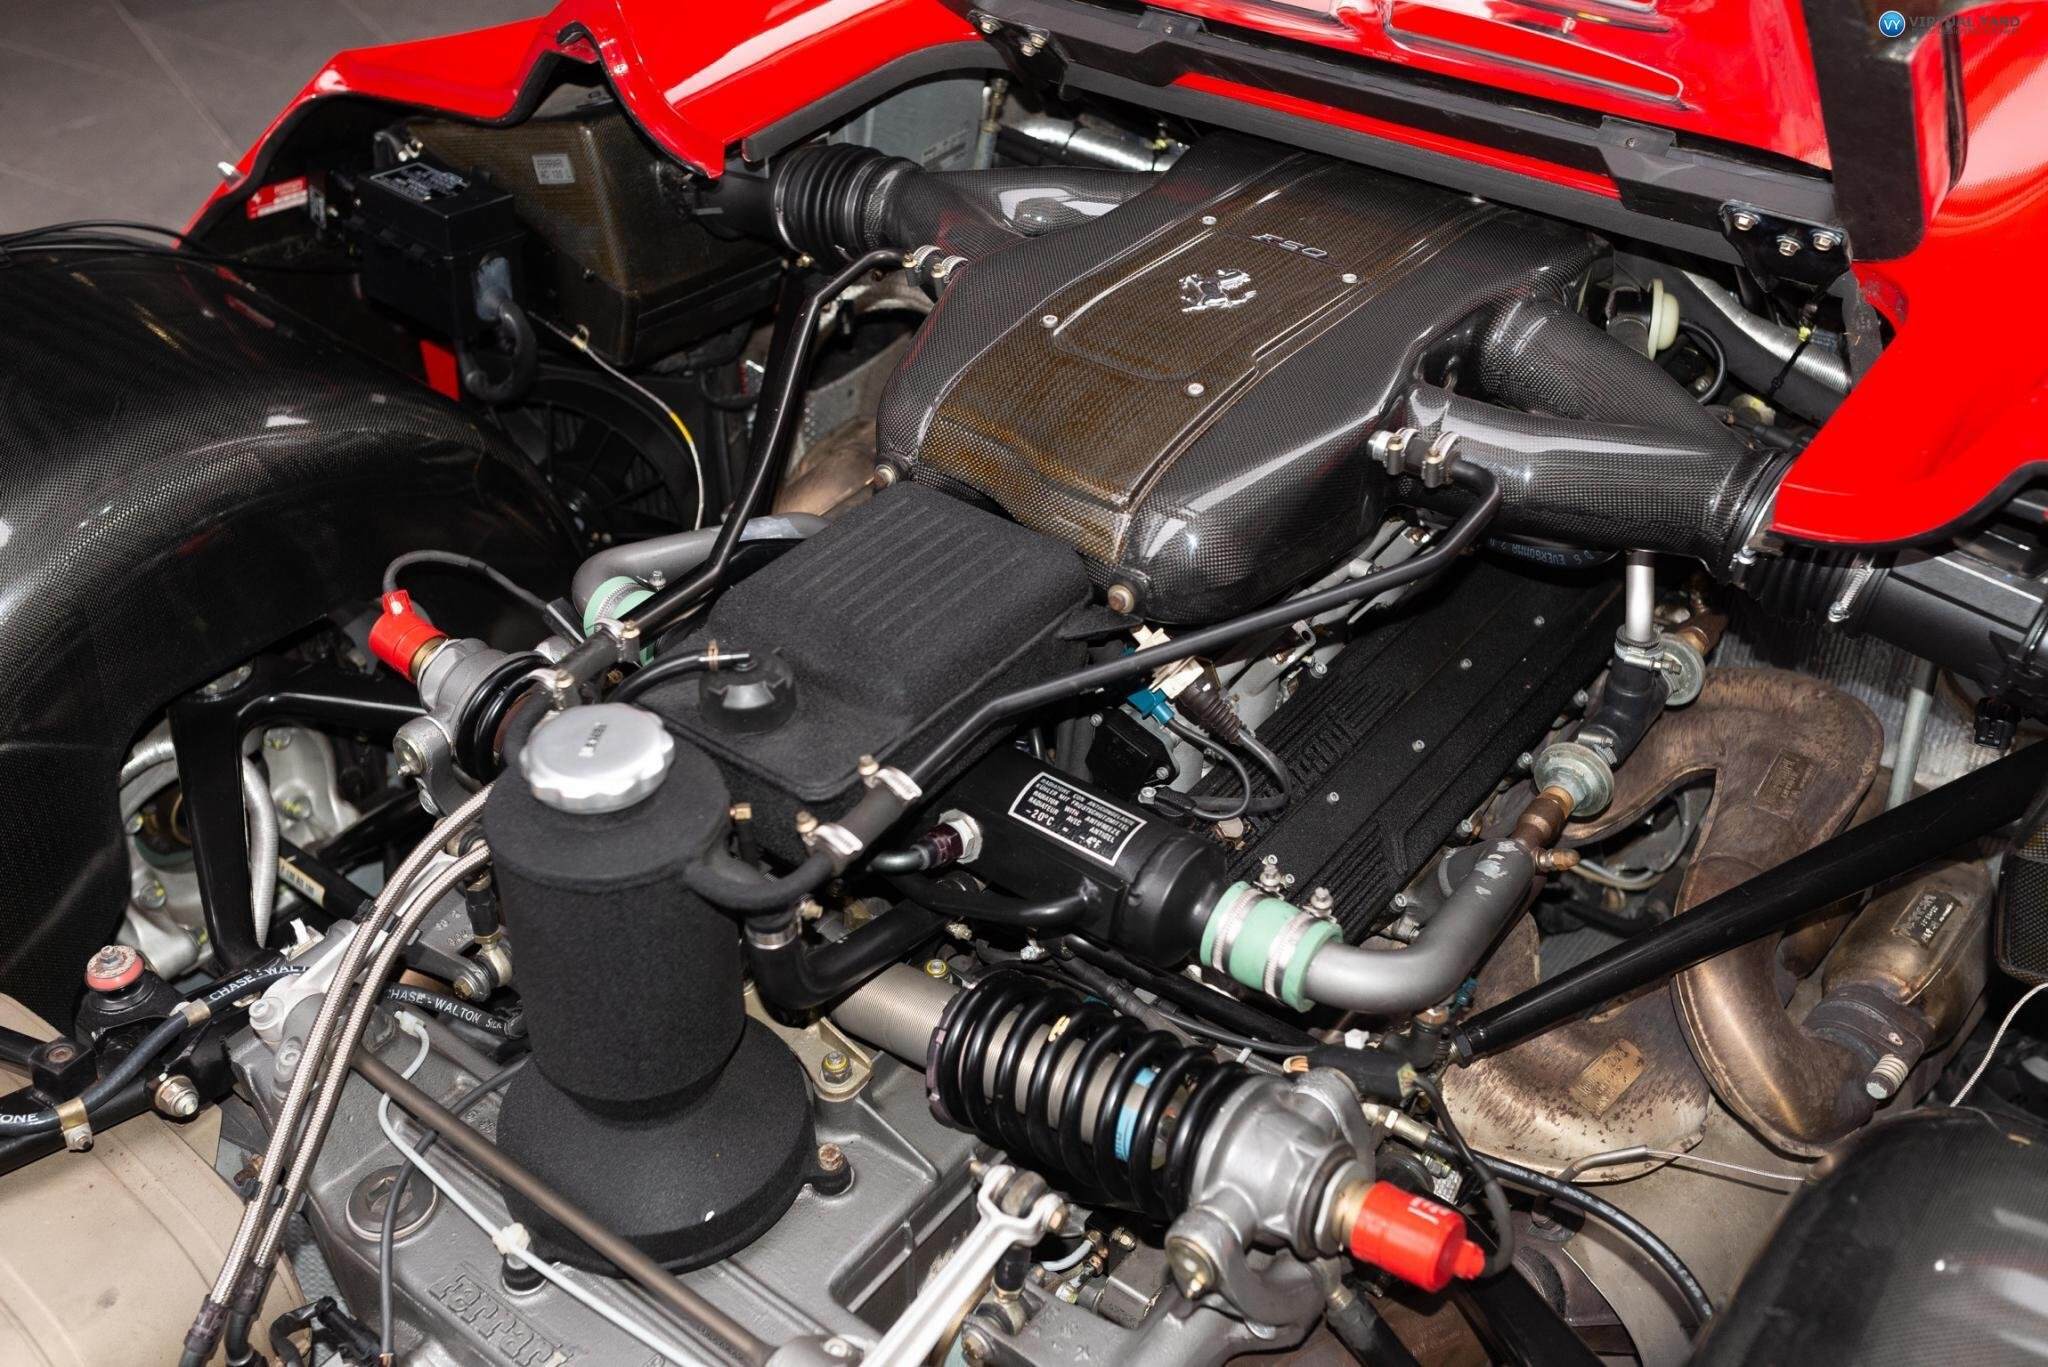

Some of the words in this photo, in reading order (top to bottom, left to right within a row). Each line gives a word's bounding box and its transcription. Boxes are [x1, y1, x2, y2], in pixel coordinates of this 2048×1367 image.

[1249, 233, 1328, 258] F50
[1040, 778, 1071, 795] RADIATORE
[1072, 793, 1086, 803] CON
[1058, 793, 1071, 802] MIT
[1028, 796, 1059, 816] RADIATEUR
[1065, 815, 1082, 827] AVEC
[1088, 826, 1115, 844] ANTIGEL
[1032, 790, 1060, 806] RADIATOR
[1064, 805, 1080, 817] WITH
[1084, 816, 1121, 837] ANTIFREEZE
[209, 974, 257, 1001] CHASE
[387, 988, 426, 1004] HASE
[434, 998, 482, 1025] WALTON
[0, 1113, 39, 1125] ONE
